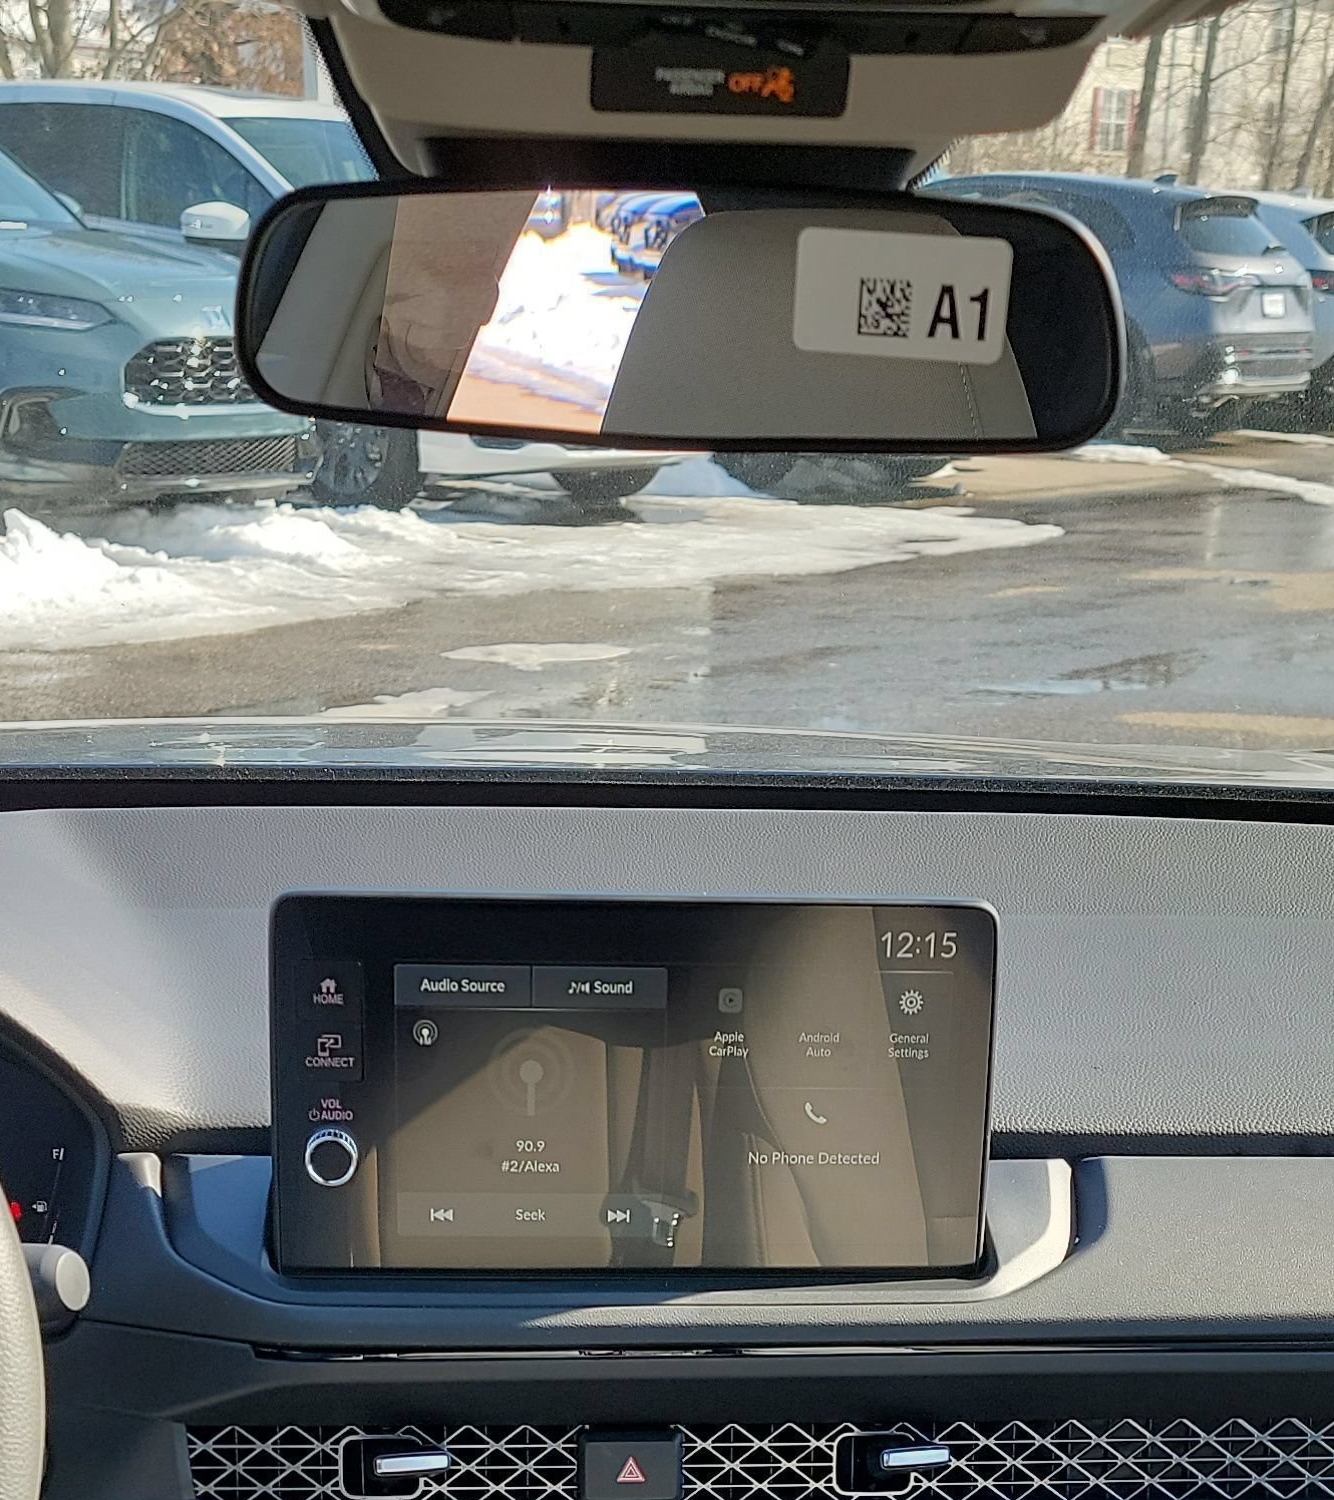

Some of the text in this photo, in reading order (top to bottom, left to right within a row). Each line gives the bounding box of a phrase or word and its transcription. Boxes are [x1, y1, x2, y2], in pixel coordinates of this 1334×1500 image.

[927, 284, 990, 341] A1
[881, 931, 958, 959] 12:15
[420, 978, 506, 993] Audio Source
[593, 980, 634, 995] Sound
[313, 993, 345, 1005] HOME
[714, 1031, 745, 1045] Apple
[798, 1033, 840, 1043] Android
[889, 1033, 930, 1044] General
[709, 1046, 749, 1059] CarPlay
[805, 1047, 832, 1058] Auto
[888, 1047, 930, 1060] Settings
[305, 1056, 355, 1068] CONNECT
[321, 1098, 342, 1109] VOL
[321, 1109, 353, 1121] AUDIO
[516, 1140, 545, 1153] 90.9
[748, 1151, 879, 1166] No Phone Detected
[501, 1159, 560, 1174] #2/Alexa
[515, 1208, 546, 1222] Seek
